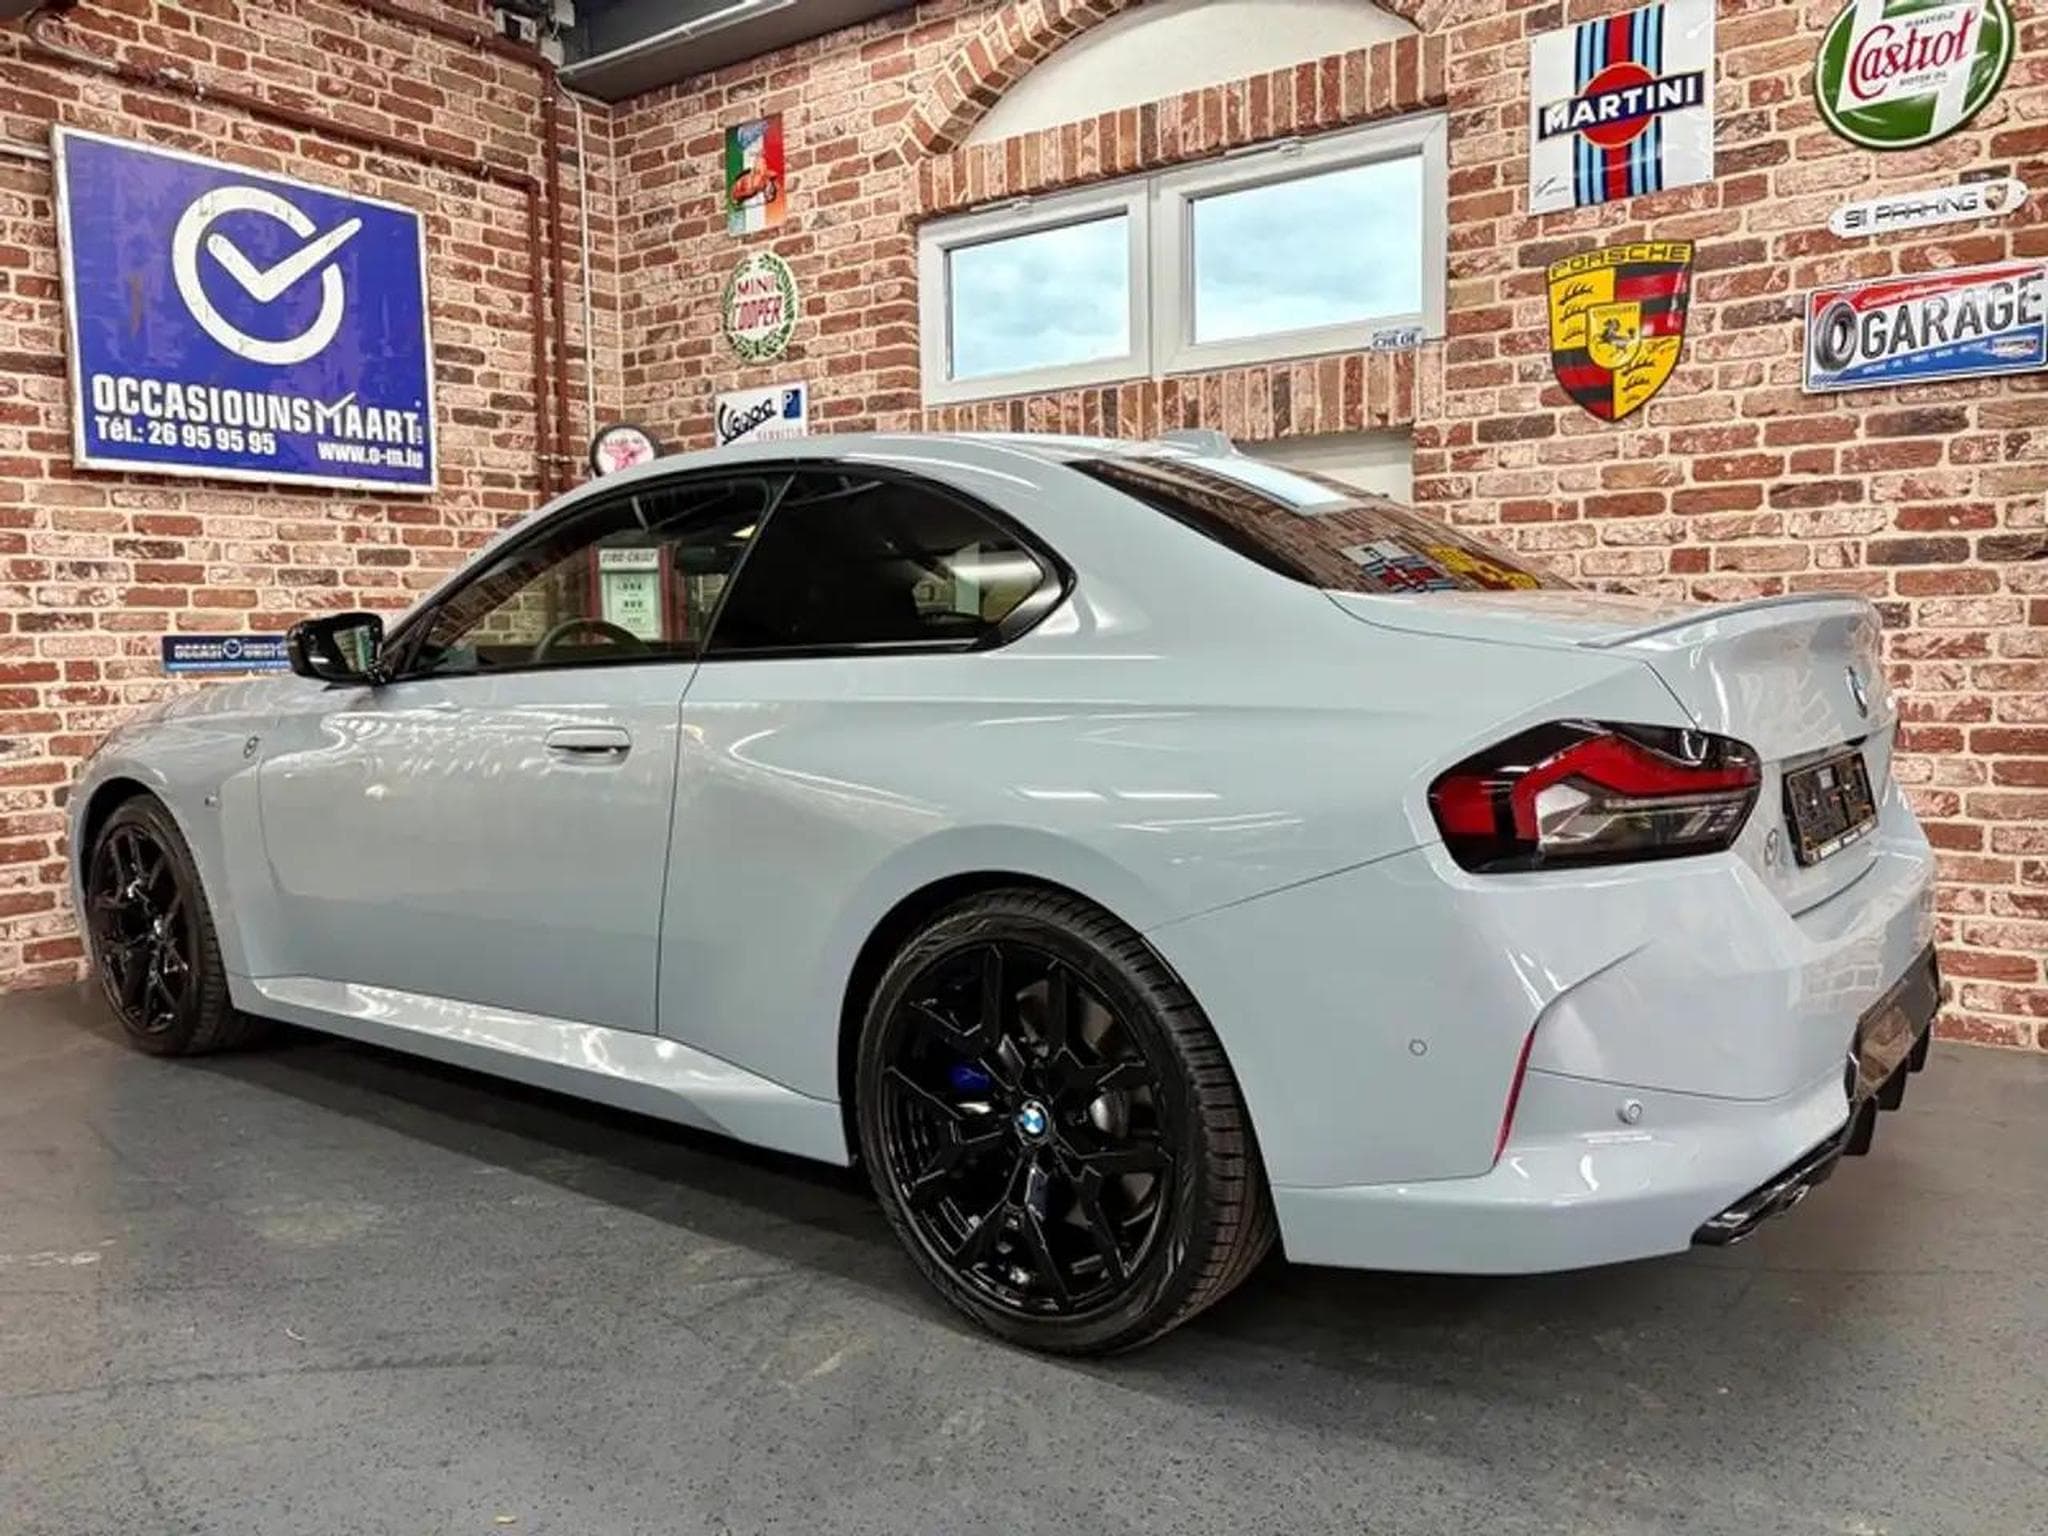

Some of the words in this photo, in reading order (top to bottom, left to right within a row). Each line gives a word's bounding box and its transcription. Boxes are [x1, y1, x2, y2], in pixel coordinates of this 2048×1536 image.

[1849, 9, 1978, 100] Castrol
[1543, 76, 1696, 136] MARTINI
[1874, 192, 1979, 224] PARKING
[1551, 244, 1688, 279] PORSCHE
[1860, 272, 2045, 360] GARAGE
[91, 373, 419, 445] OCCASIOUNSMAART
[718, 401, 778, 446] Vespa
[147, 419, 178, 447] 26
[181, 423, 212, 450] 95
[215, 426, 245, 453] 95
[247, 430, 277, 456] 95
[317, 440, 425, 470] www.o-m.lu
